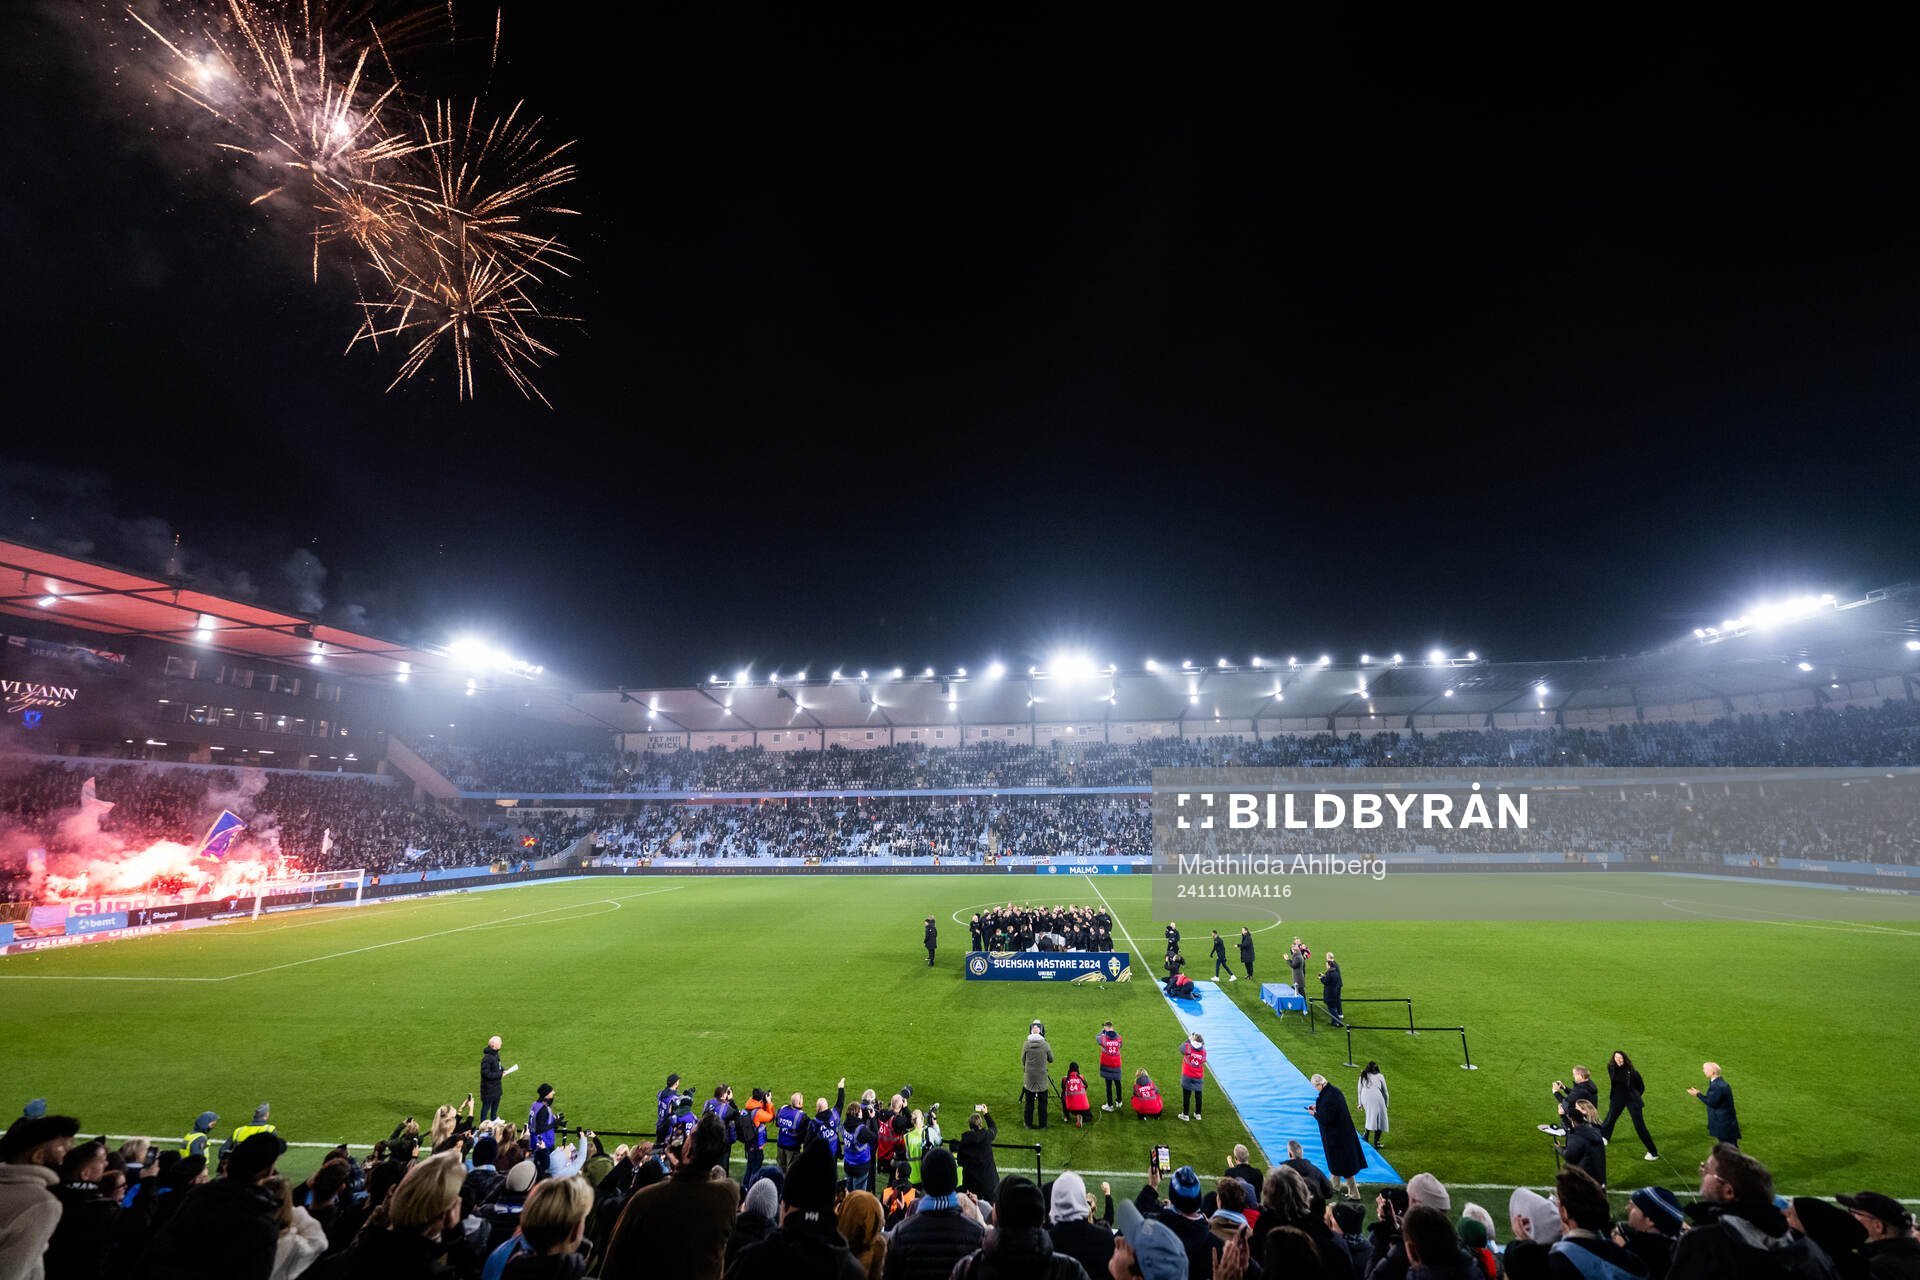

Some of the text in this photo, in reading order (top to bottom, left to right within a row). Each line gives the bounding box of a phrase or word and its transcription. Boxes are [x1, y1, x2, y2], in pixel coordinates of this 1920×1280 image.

[1, 680, 22, 694] VI
[1069, 865, 1099, 874] MALMÖ
[993, 958, 1101, 969] SVENSKA MÄSTARE 2024
[780, 1118, 793, 1127] FOTO
